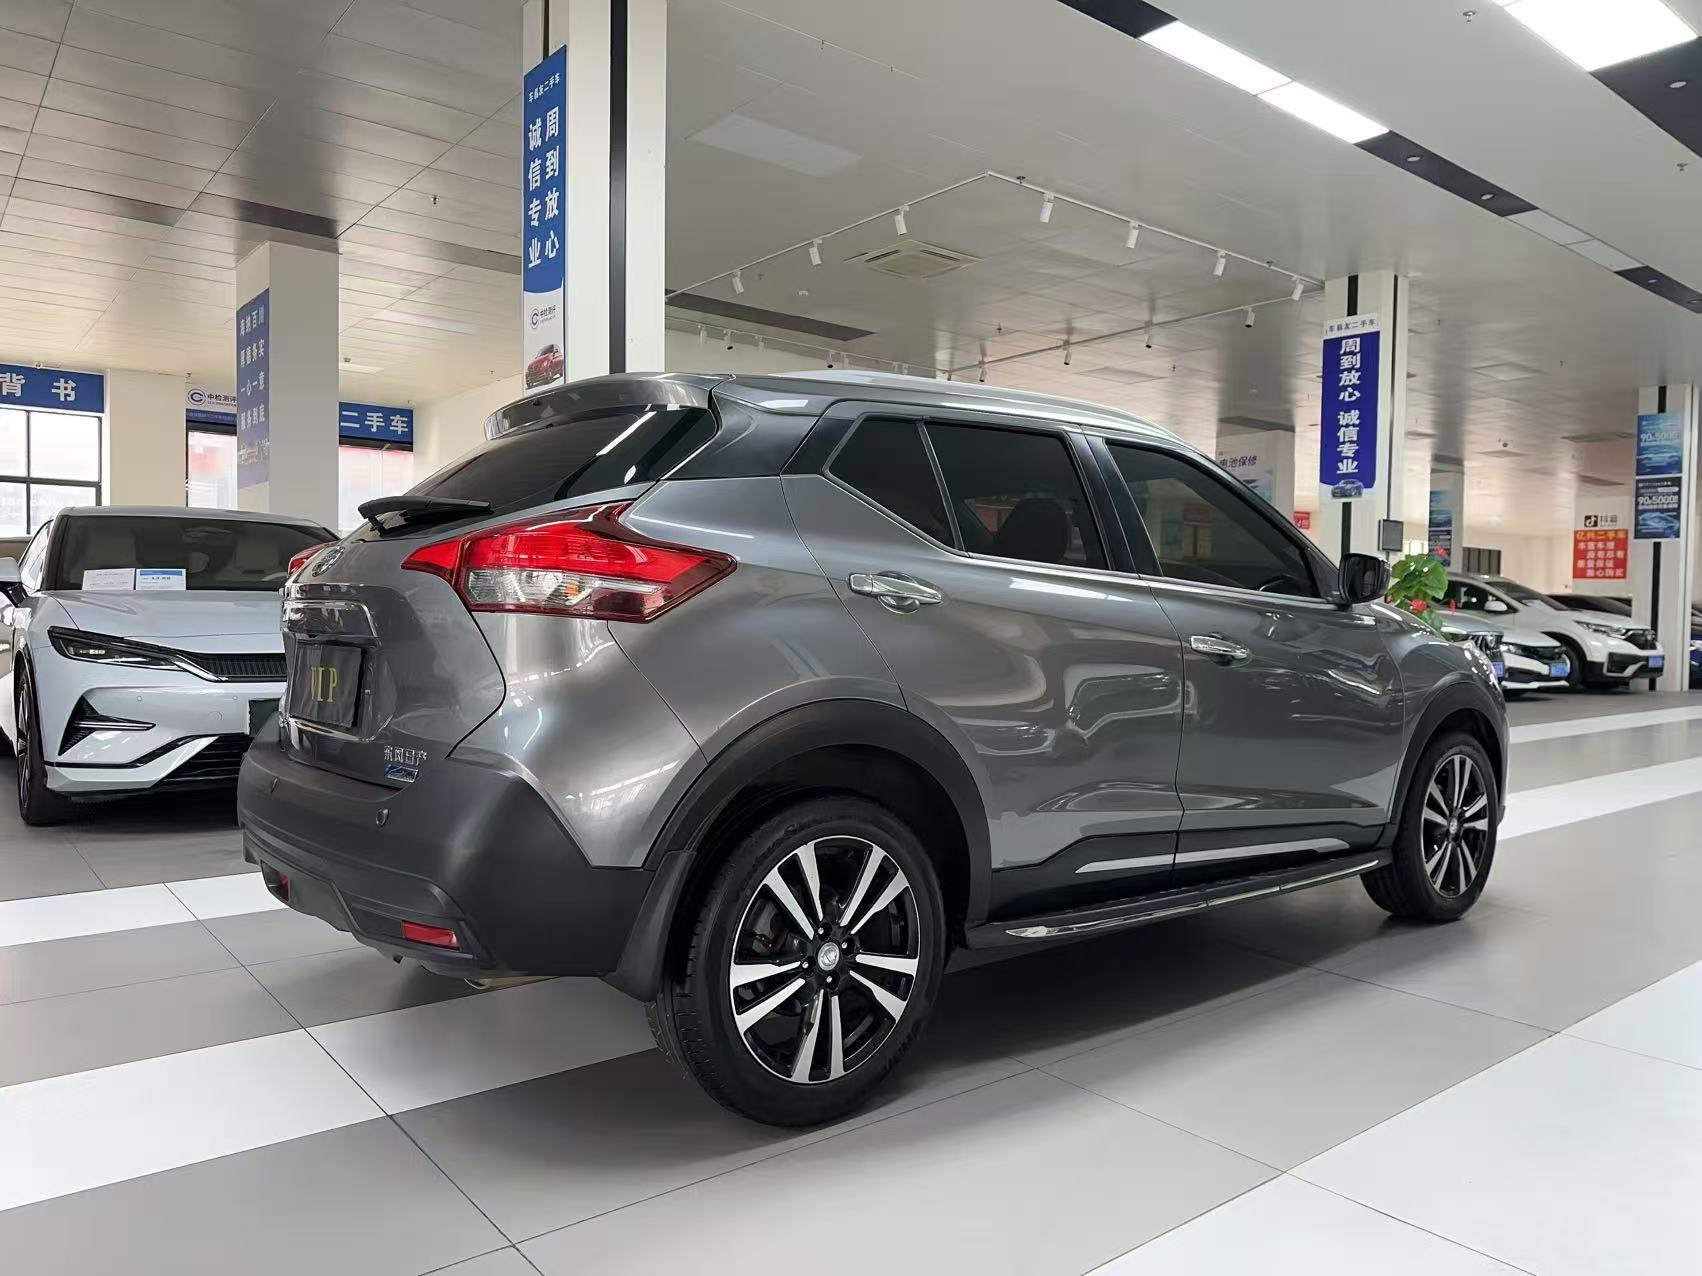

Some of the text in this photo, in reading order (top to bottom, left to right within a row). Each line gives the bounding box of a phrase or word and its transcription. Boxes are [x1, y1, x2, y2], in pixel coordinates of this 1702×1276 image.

[528, 118, 542, 269] 诚信专业
[545, 106, 560, 259] 周到放心
[240, 371, 265, 397] 一心一意
[340, 410, 409, 435] 二手车
[1336, 337, 1361, 474] 周到放心 诚信专业
[1219, 455, 1258, 468] 电池保修
[311, 666, 338, 703] VIP
